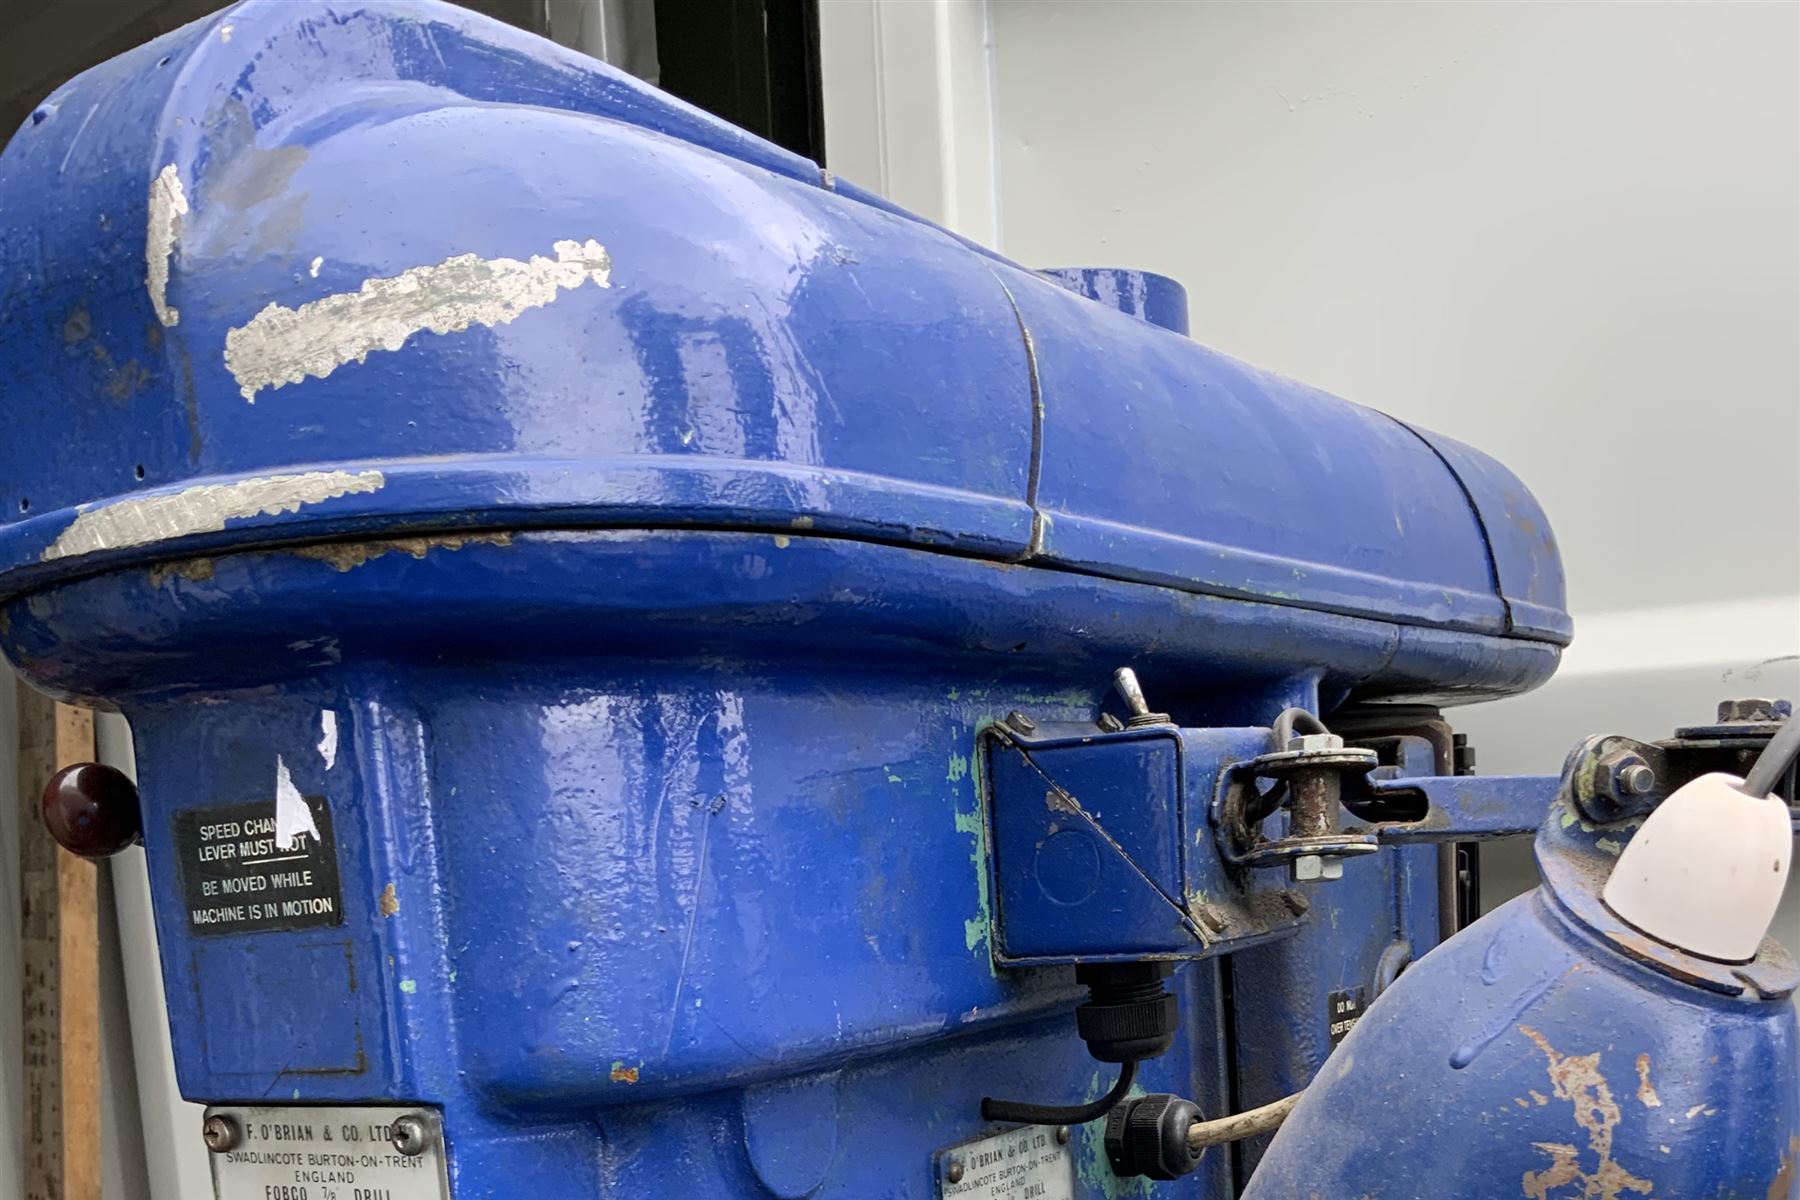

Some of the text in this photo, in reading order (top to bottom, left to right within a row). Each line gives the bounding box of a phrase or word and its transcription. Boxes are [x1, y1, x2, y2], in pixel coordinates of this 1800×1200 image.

[200, 817, 277, 841] SPEED CHAN
[199, 834, 307, 861] LEVER MUST OT
[202, 871, 313, 896] BE MOVED WHILE
[192, 897, 333, 924] MACHINE IS IN MOTION
[261, 1124, 313, 1141] O'BRIAN
[323, 1124, 333, 1141] &
[342, 1125, 363, 1142] CO.
[226, 1152, 424, 1168] SWADLINCOTE BURTON-ON-TRENT
[970, 1149, 1003, 1169] O'BRIAN
[1008, 1145, 1015, 1157] &
[295, 1171, 355, 1183] ENGLAND
[948, 1173, 996, 1197] SWADLINCOTE
[999, 1152, 1060, 1180] BURTON-ON-TRENT
[991, 1176, 1025, 1196] ENGLAND
[1024, 1182, 1045, 1199] DRILL
